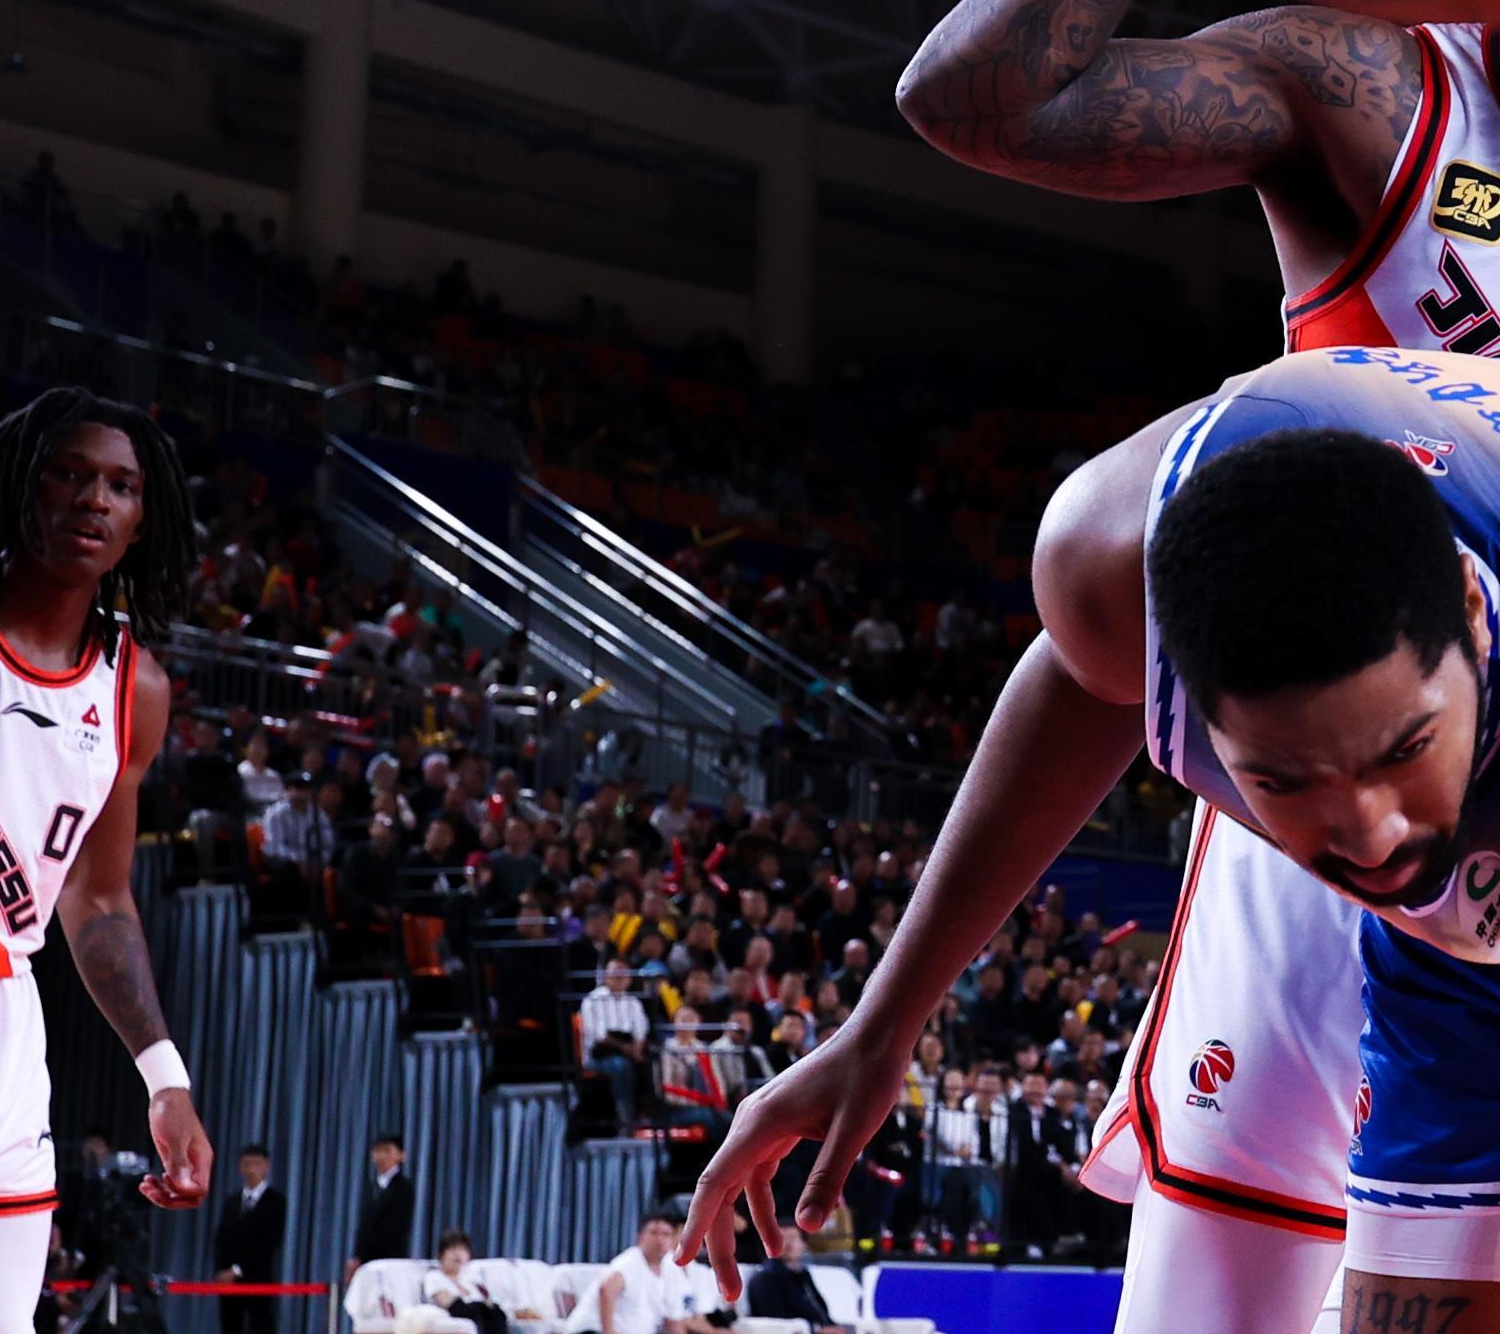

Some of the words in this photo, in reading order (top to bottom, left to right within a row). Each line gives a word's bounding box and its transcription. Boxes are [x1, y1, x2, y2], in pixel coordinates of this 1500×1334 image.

[1452, 210, 1492, 230] CBA
[42, 804, 85, 861] 0
[1186, 1094, 1222, 1112] CBA
